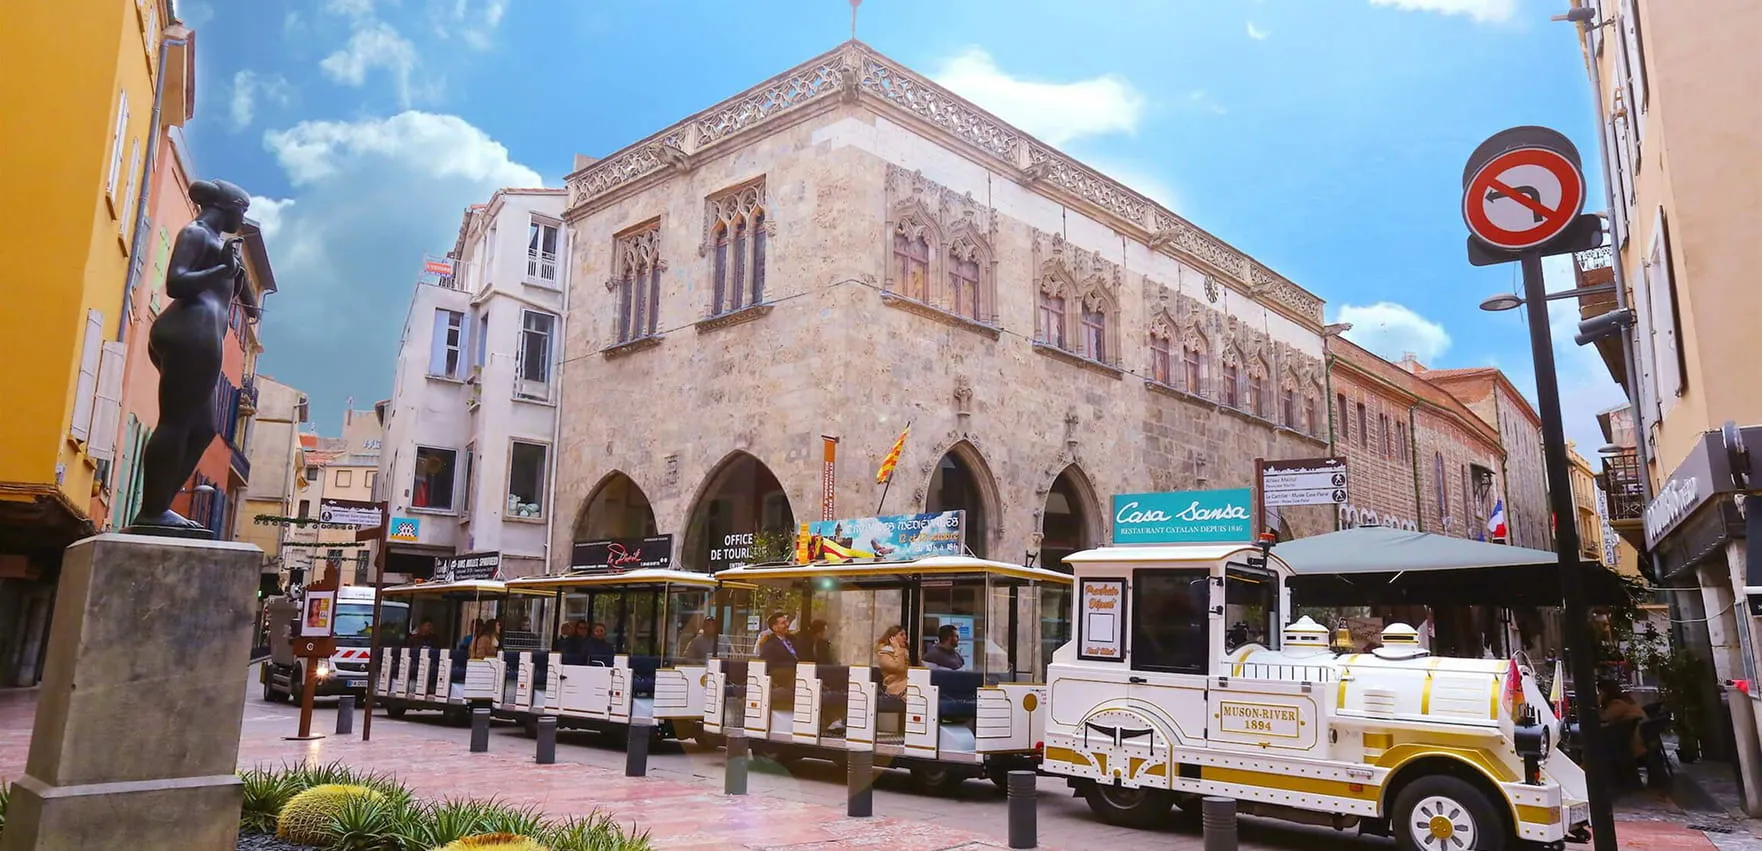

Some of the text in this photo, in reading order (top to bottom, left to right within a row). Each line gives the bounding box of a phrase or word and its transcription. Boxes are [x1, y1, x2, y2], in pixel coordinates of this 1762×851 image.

[1116, 501, 1250, 523] Casa Sansa
[1120, 527, 1165, 535] RESTAURANT
[1166, 526, 1200, 534] CATALAN
[1200, 525, 1227, 533] DEPUIS
[724, 533, 753, 546] OFFICE
[711, 547, 767, 560] DE TOURIE
[1223, 706, 1296, 721] MUSON-RIVER
[1245, 720, 1272, 731] 1894
